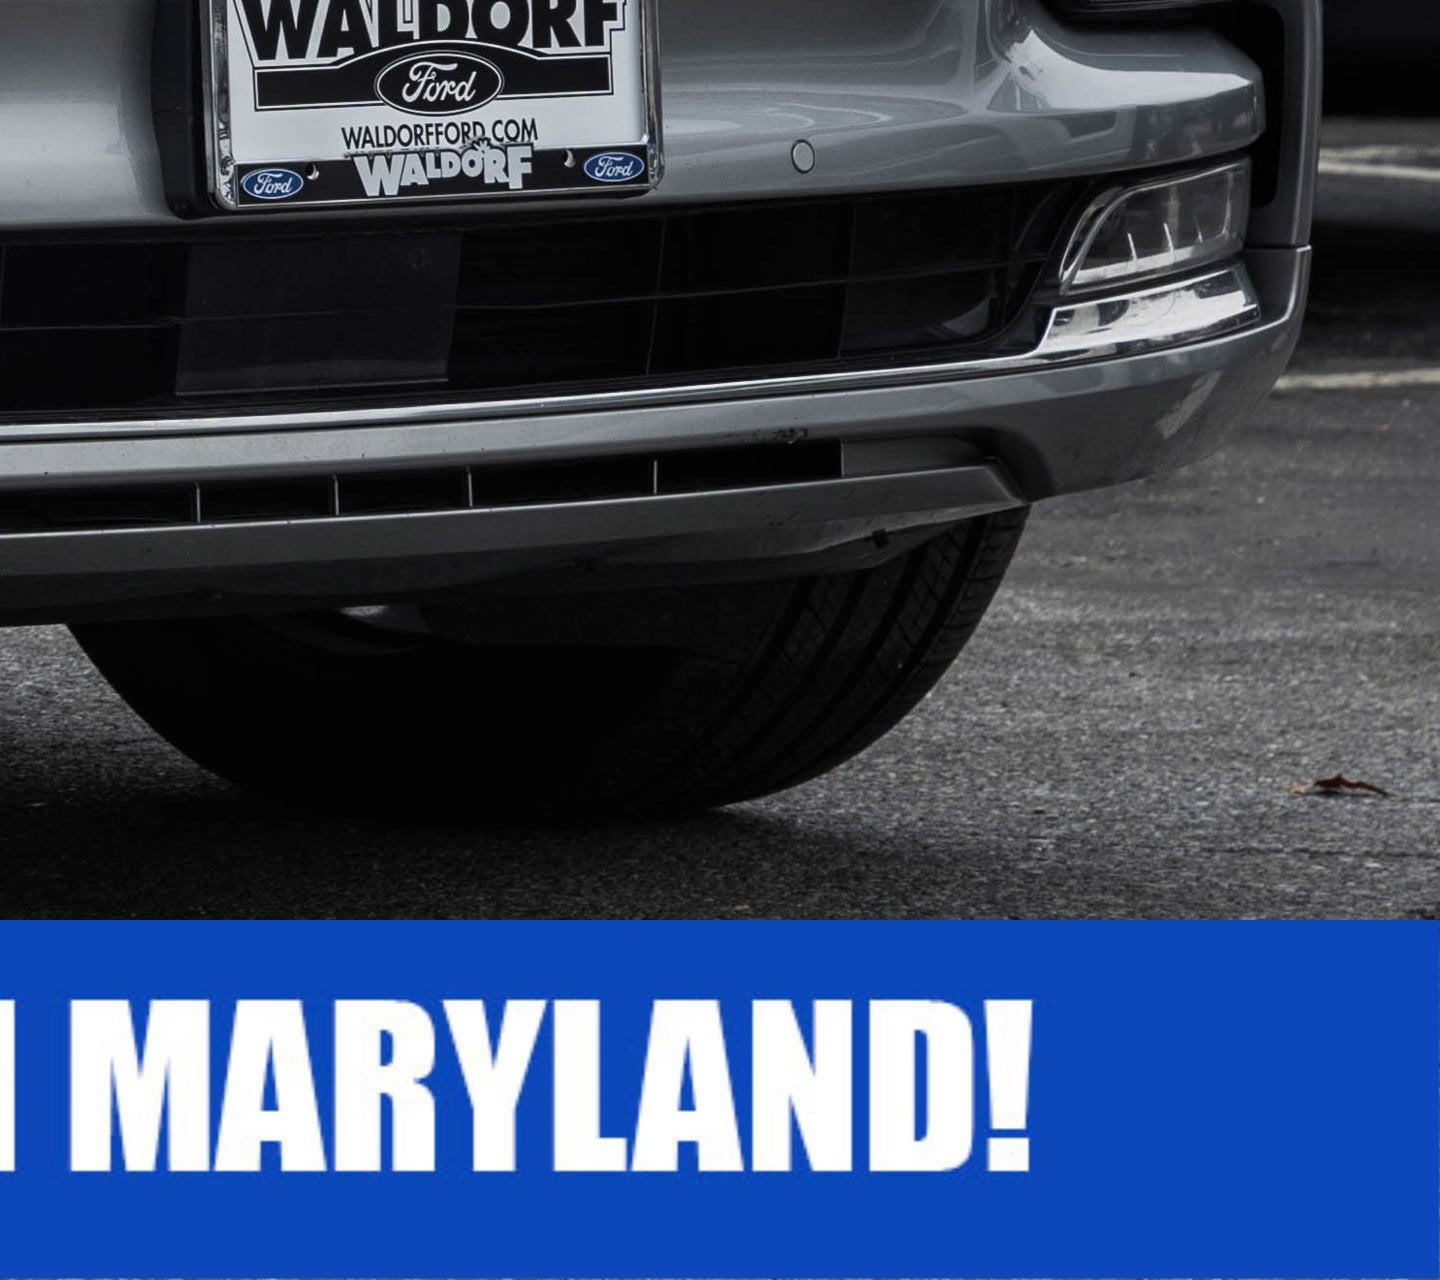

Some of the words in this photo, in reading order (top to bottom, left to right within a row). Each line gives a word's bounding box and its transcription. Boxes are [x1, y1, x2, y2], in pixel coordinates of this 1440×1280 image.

[401, 59, 477, 104] Ford
[340, 117, 539, 150] WALDORFFORDCOM
[250, 171, 295, 196] Ford
[353, 142, 534, 197] WALDORF
[593, 154, 637, 180] Ford
